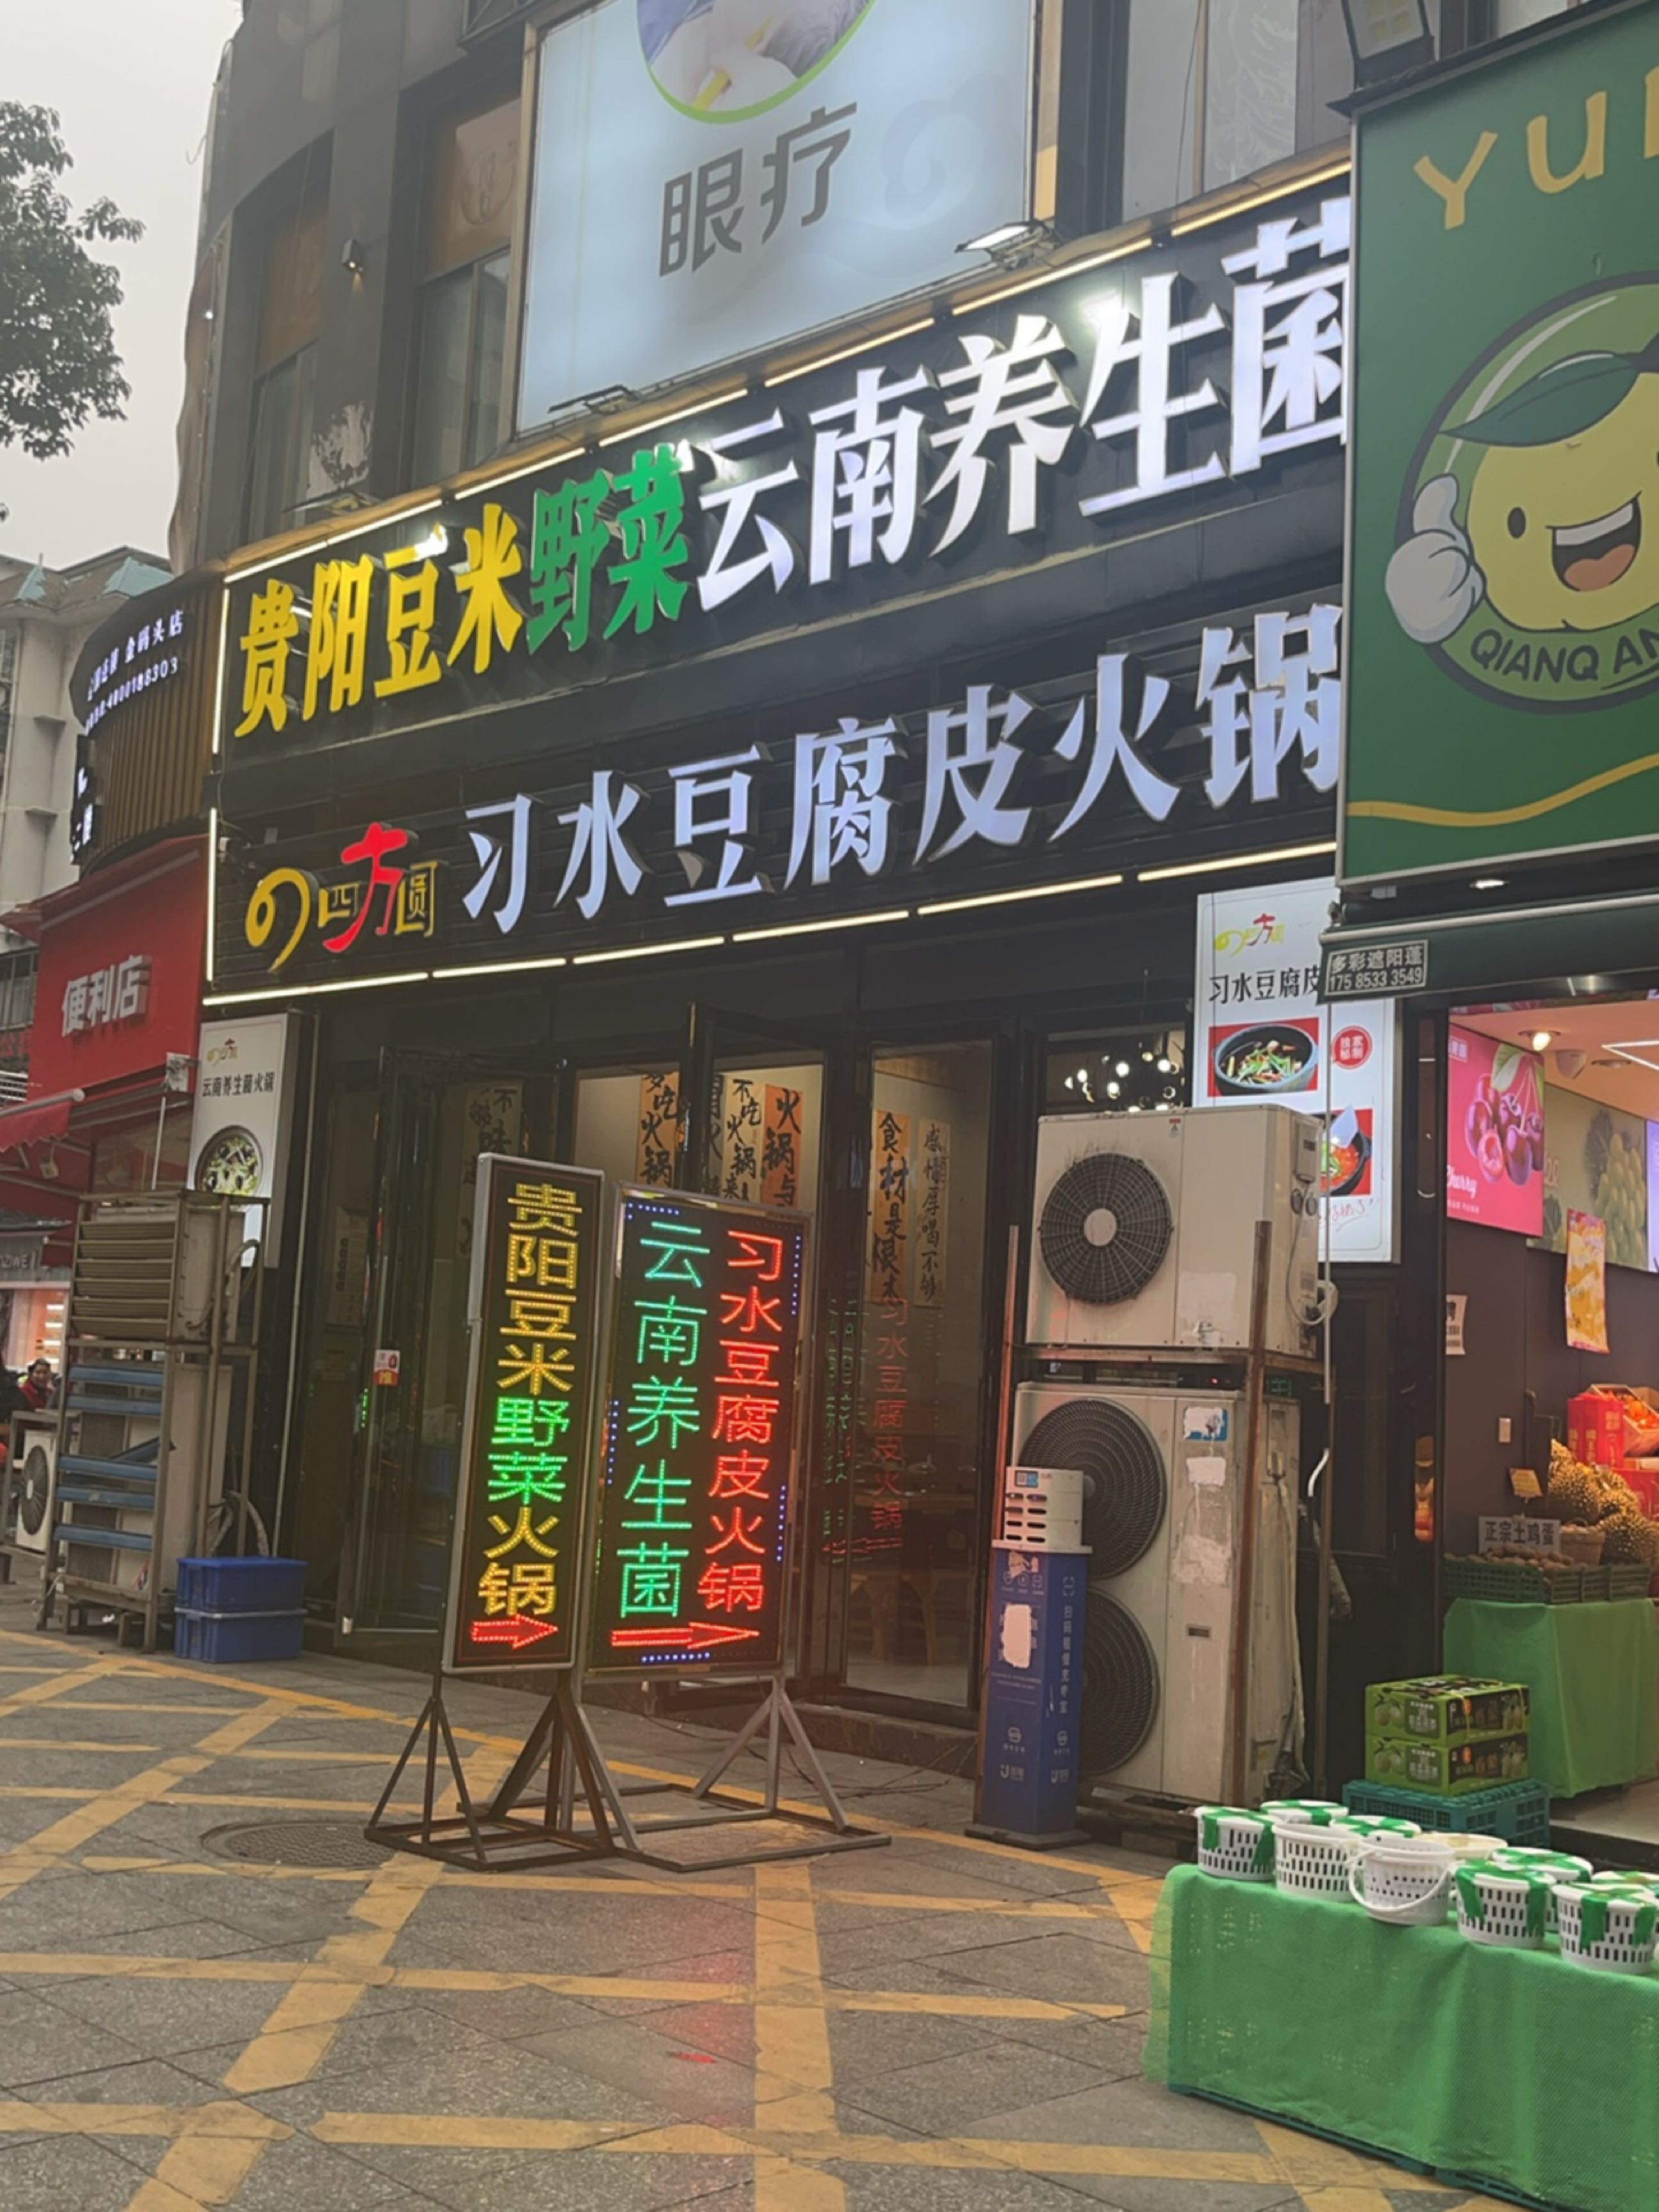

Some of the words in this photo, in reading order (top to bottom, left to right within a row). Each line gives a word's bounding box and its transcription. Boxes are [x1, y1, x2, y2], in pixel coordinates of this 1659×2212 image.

[659, 102, 858, 278] 眼疗
[462, 604, 1343, 934] 习水豆腐皮火锅
[61, 956, 151, 1039] 便利店
[1330, 973, 1352, 990] 175
[1355, 970, 1387, 988] 8533
[1391, 966, 1422, 985] 3549
[477, 1182, 583, 1617] 贵阳豆米野菜火锅
[616, 1221, 710, 1619] 云南养生菌
[696, 1230, 784, 1614] 习水豆腐皮火锅
[1485, 1521, 1554, 1547] 正宗土鸡蛋
